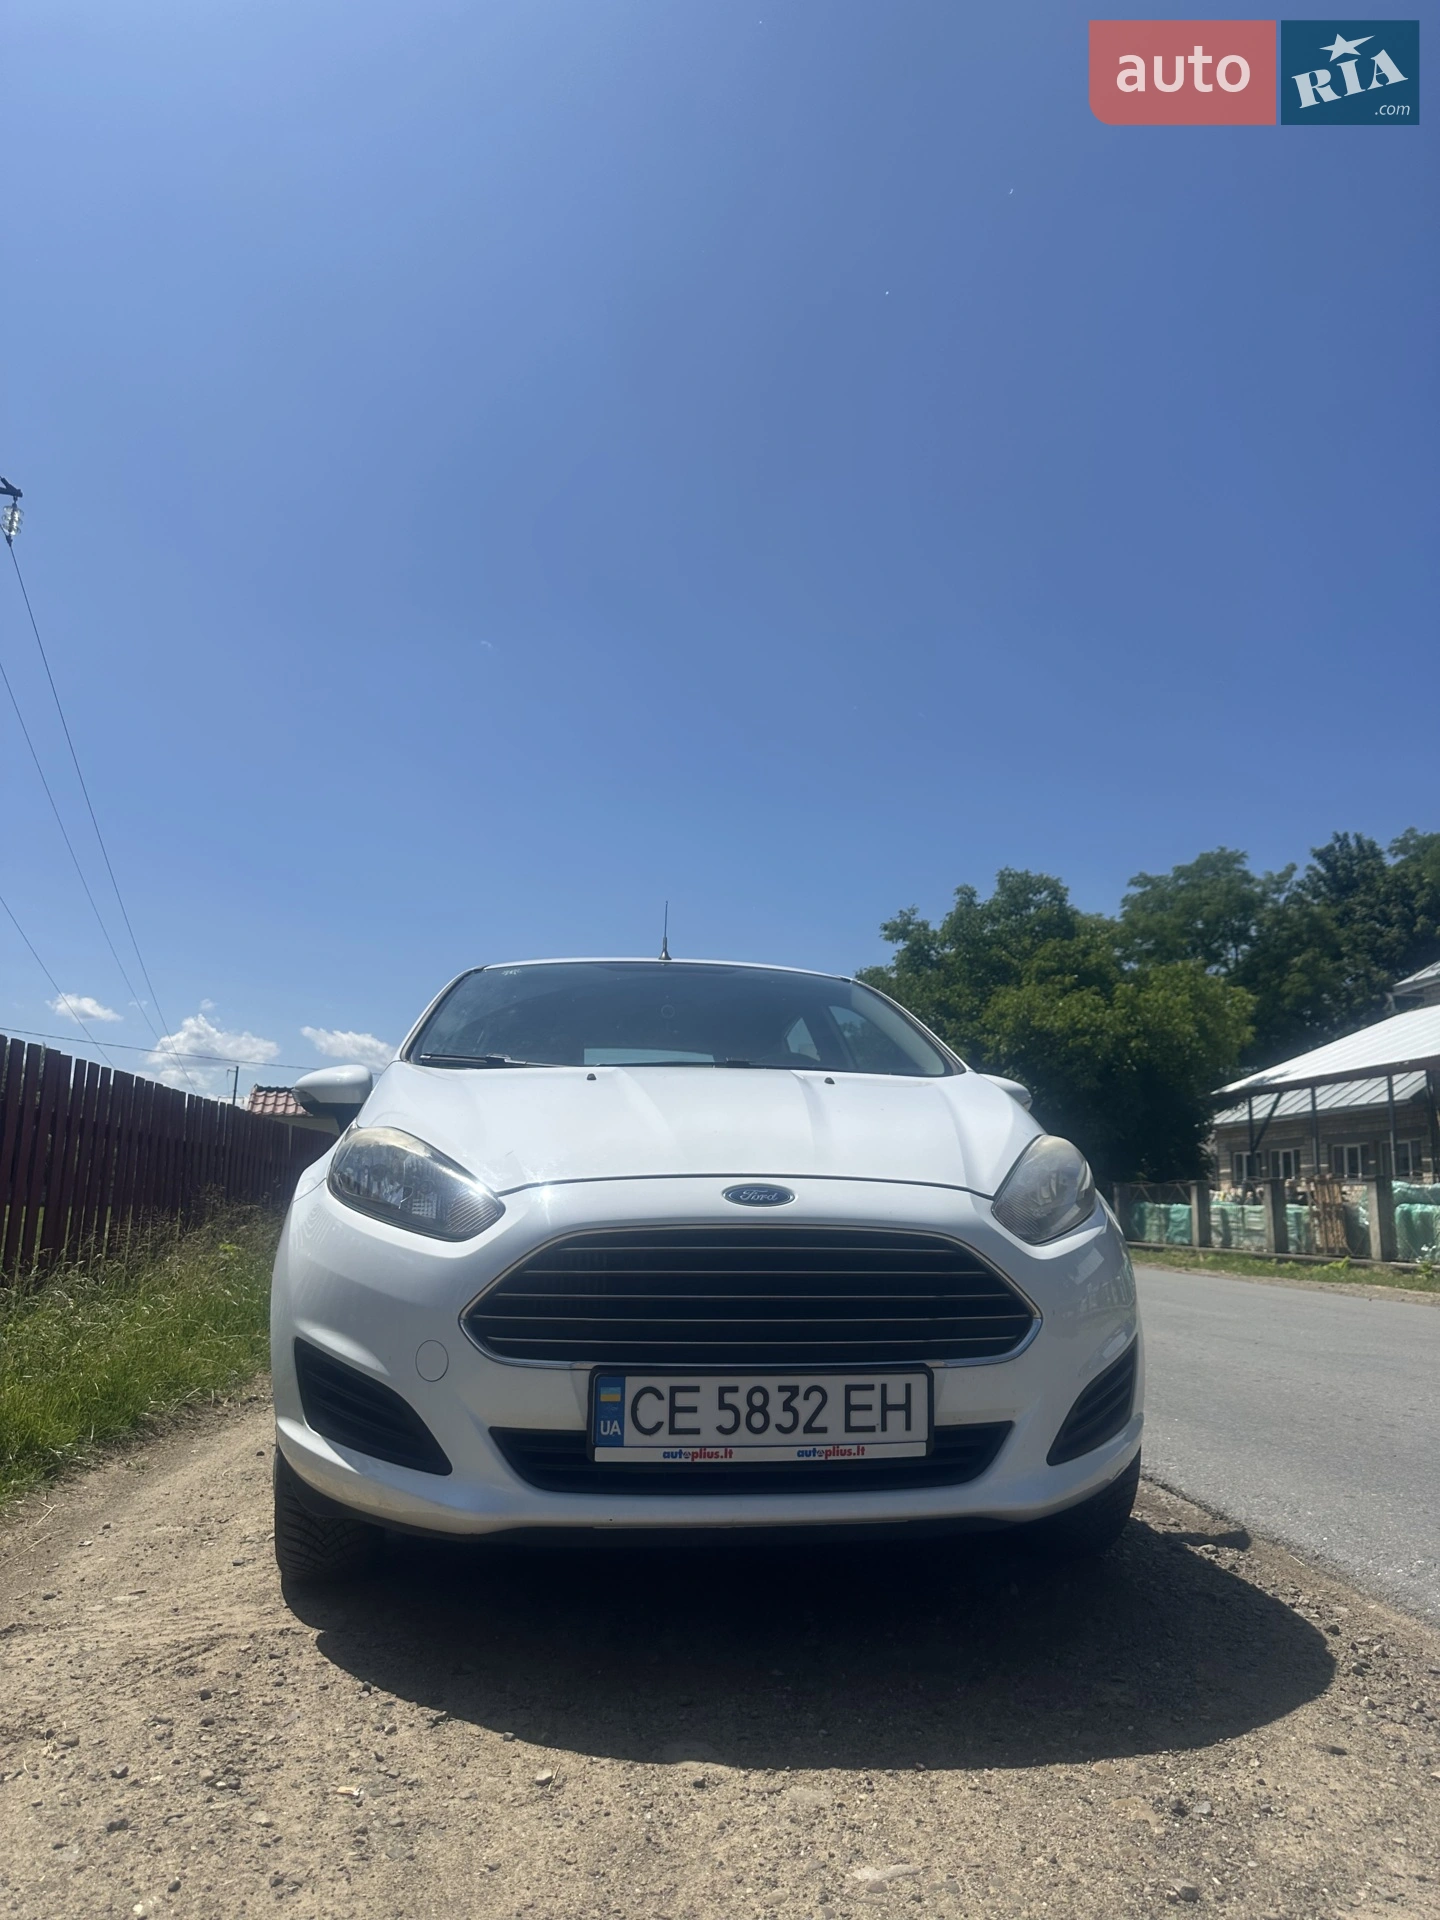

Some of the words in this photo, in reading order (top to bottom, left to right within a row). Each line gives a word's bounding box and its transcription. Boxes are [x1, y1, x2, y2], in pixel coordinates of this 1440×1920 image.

[739, 1189, 778, 1201] Ford
[630, 1385, 701, 1436] CE
[715, 1384, 828, 1435] 5832
[844, 1383, 912, 1433] EH
[600, 1420, 621, 1436] UA
